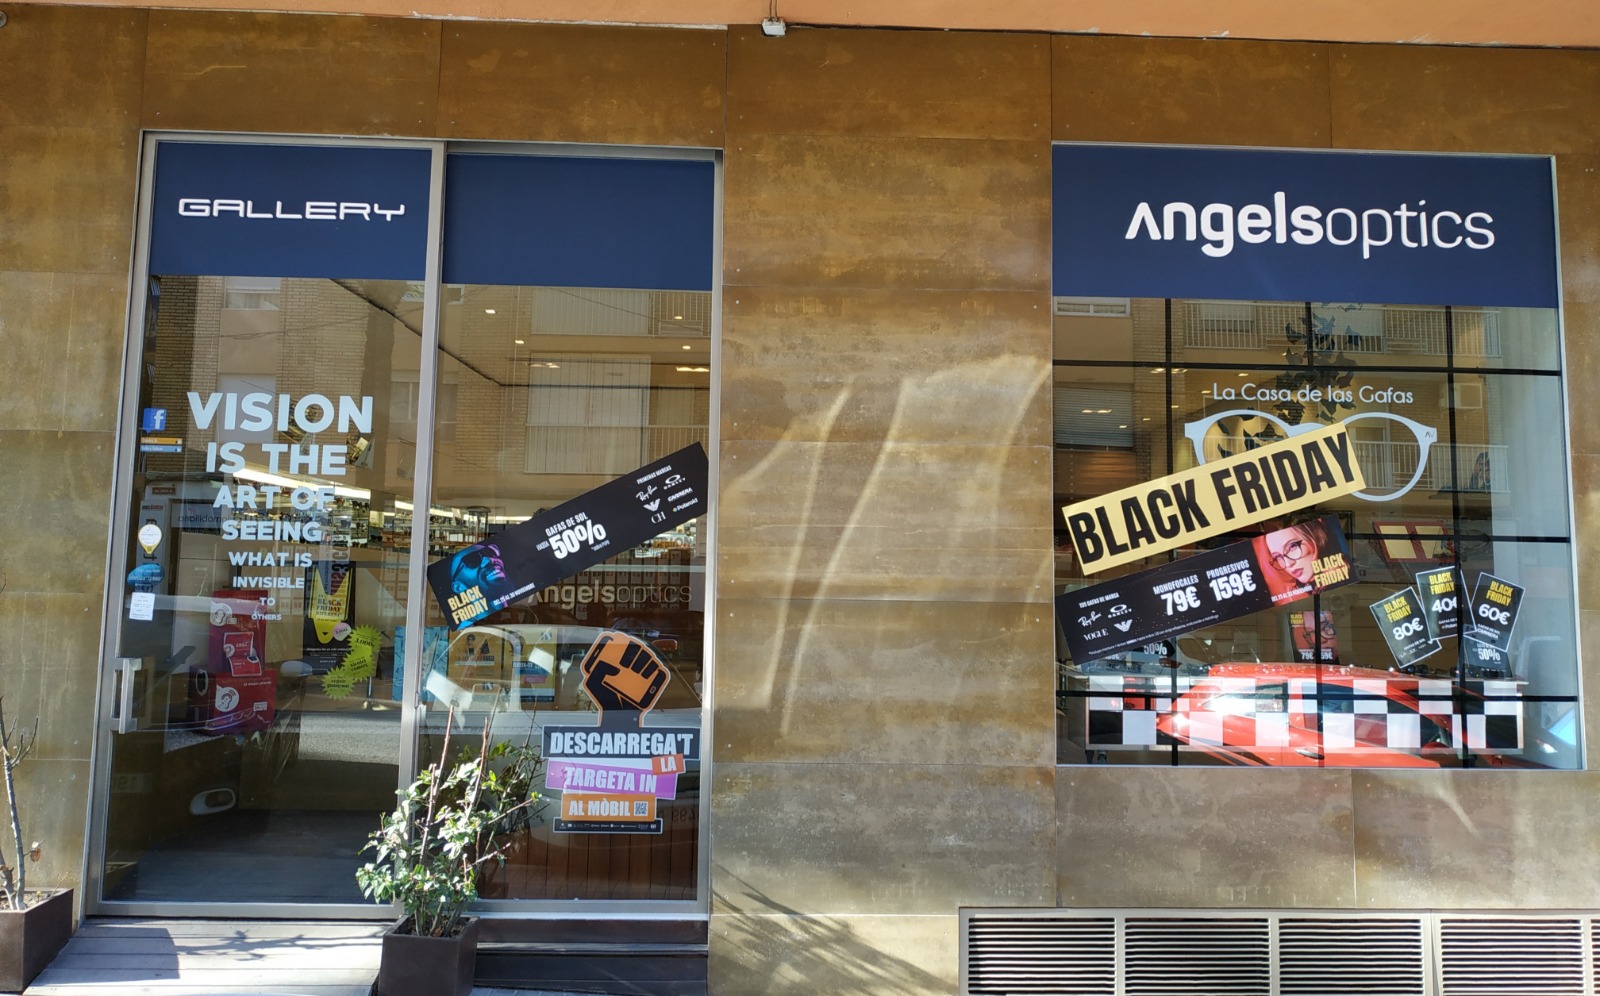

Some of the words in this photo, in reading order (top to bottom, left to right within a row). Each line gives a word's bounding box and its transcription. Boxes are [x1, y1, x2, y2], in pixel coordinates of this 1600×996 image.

[178, 197, 405, 222] GALLERY
[1124, 191, 1496, 259] Angelsoptics
[1213, 382, 1236, 400] La
[1241, 383, 1291, 401] Casa
[1297, 384, 1323, 401] de
[1328, 385, 1353, 402] las
[1359, 385, 1414, 404] Gafas
[186, 391, 374, 434] VISION
[206, 441, 246, 474] IS
[261, 443, 348, 475] THE
[212, 485, 282, 509] ART
[290, 487, 336, 511] OF
[667, 487, 693, 503] CARRERA
[676, 497, 699, 511] Polaroid
[1067, 478, 1210, 565] BLACK
[1210, 431, 1355, 521] FRIDAY
[545, 521, 567, 537] GAFAS
[565, 517, 576, 527] DE
[574, 511, 588, 521] SOL
[651, 511, 667, 524] CH
[222, 519, 322, 542] SEEING
[548, 519, 607, 559] 50%
[228, 551, 289, 567] WHAT
[294, 552, 313, 568] IS
[1206, 559, 1250, 579] PROGRESIVOS
[1311, 552, 1345, 574] BLACK
[232, 576, 305, 589] INVISIBLE
[1152, 574, 1200, 595] MONOFOCALES
[1209, 569, 1257, 601] 159€
[1314, 565, 1350, 588] FRIDAY
[1429, 571, 1453, 585] BLACK
[447, 584, 483, 611] BLACK
[1104, 592, 1119, 601] MARCA
[1430, 581, 1455, 595] FRIDAY
[1486, 589, 1512, 607] FRIDAY
[1490, 580, 1513, 597] BLACK
[259, 597, 276, 606] TO
[451, 597, 489, 625] FRIDAY
[1160, 585, 1201, 616] 79€
[1383, 596, 1408, 613] BLACK
[1387, 604, 1412, 624] FRIDAY
[1478, 603, 1511, 625] 60€
[1083, 628, 1109, 641] VOGUE
[1392, 617, 1424, 640] 80€
[1477, 648, 1501, 661] 50%
[550, 731, 694, 756] DESCARREGA'T
[660, 756, 677, 772] LA
[564, 766, 636, 792] TARGETA
[639, 774, 658, 793] IN
[569, 800, 584, 816] AL
[587, 797, 631, 817] MÒBIL
